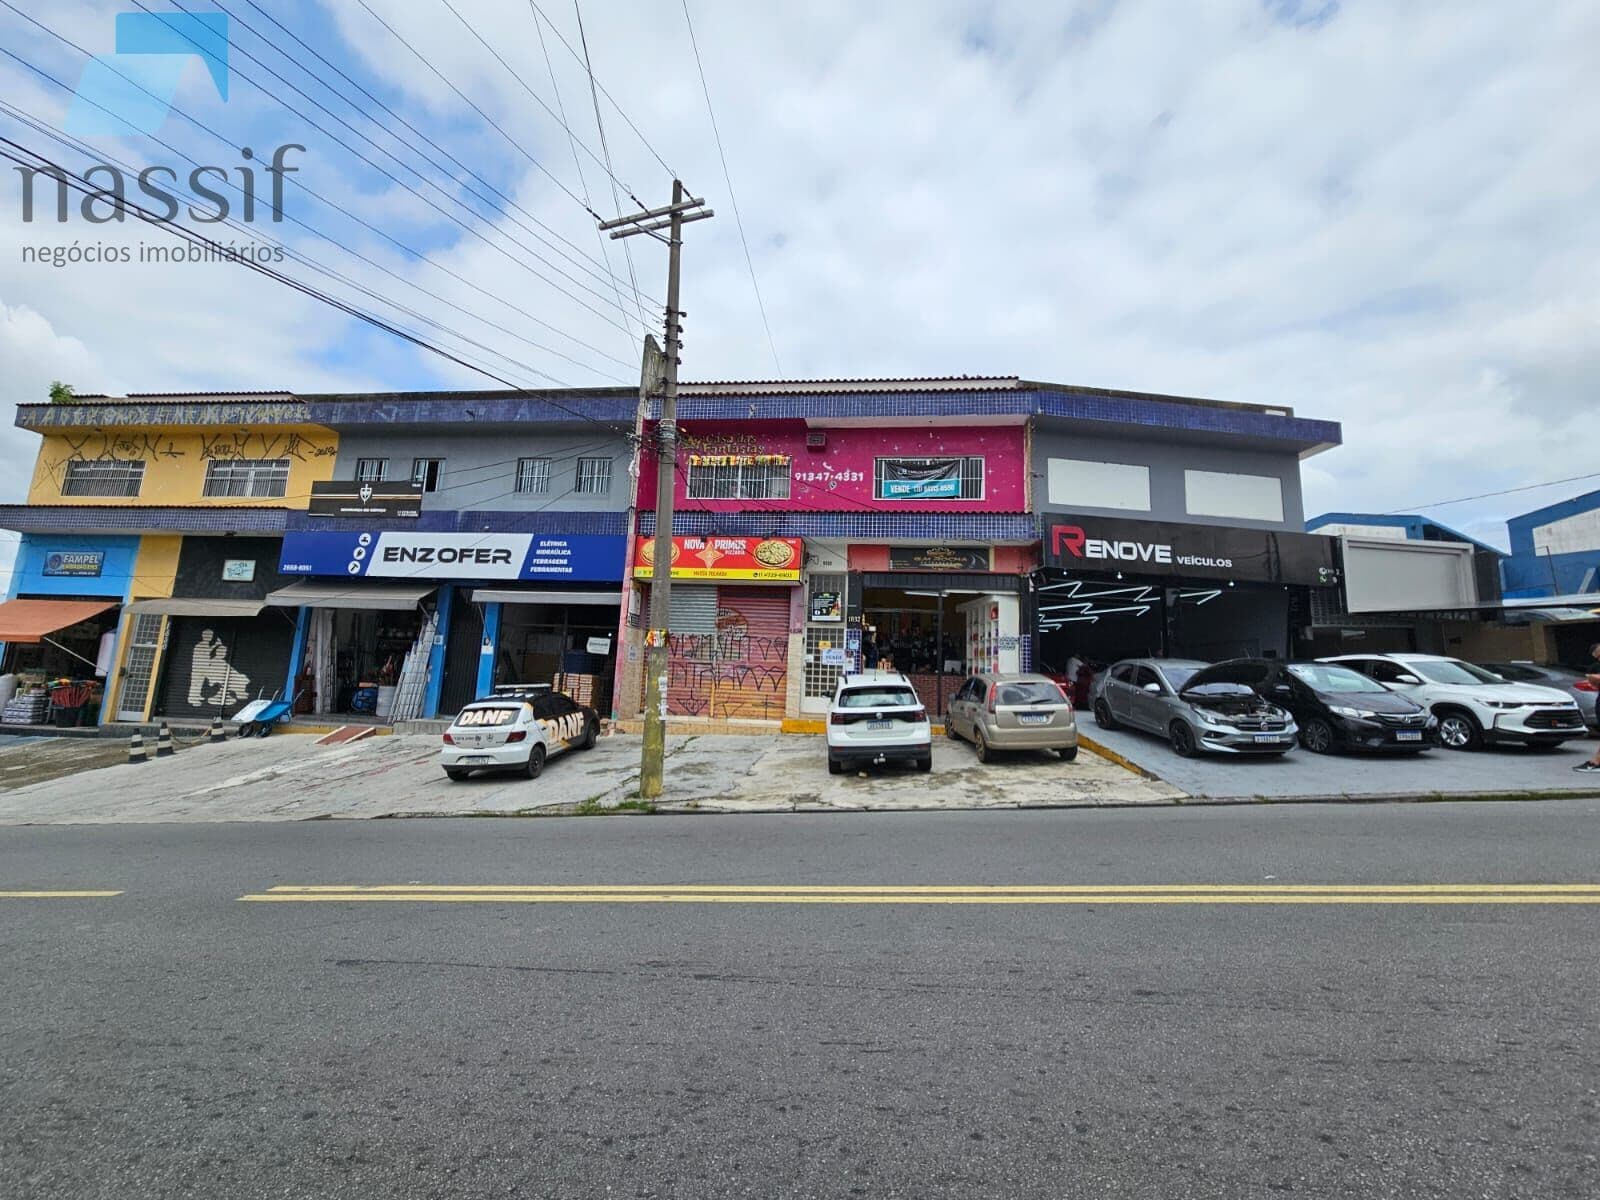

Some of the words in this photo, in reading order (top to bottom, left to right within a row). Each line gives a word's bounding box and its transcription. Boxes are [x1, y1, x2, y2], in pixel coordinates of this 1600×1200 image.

[684, 538, 706, 550] NOVA
[1050, 524, 1173, 564] RENOVE
[1176, 554, 1233, 568] VEÍCULOS
[382, 546, 513, 565] ENZOFER
[458, 710, 513, 726] DANF
[550, 711, 585, 743] DANF
